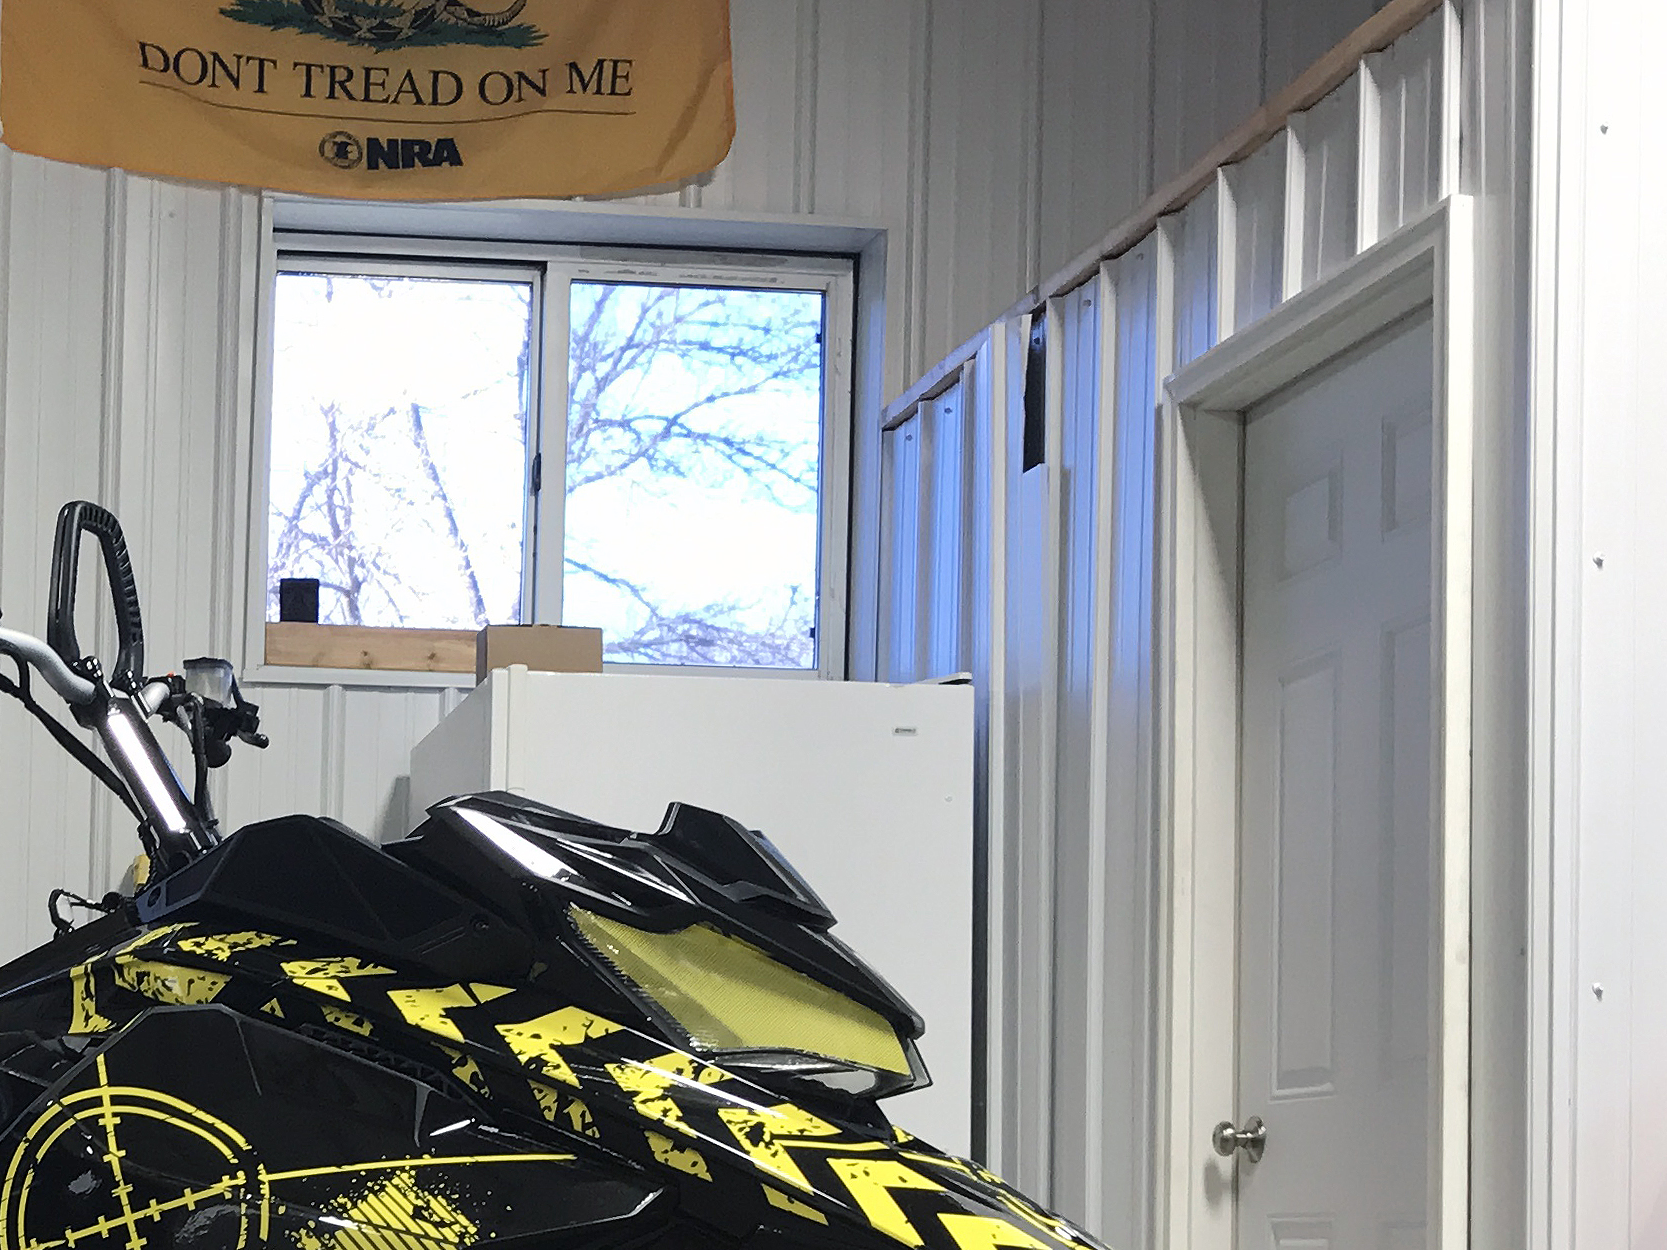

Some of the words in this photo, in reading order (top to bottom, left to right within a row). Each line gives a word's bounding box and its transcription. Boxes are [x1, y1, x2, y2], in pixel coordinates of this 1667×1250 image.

[138, 41, 278, 94] DONT
[293, 61, 464, 106] TREAD
[478, 68, 550, 106] ON
[565, 58, 635, 97] ME
[366, 137, 464, 171] NRA
